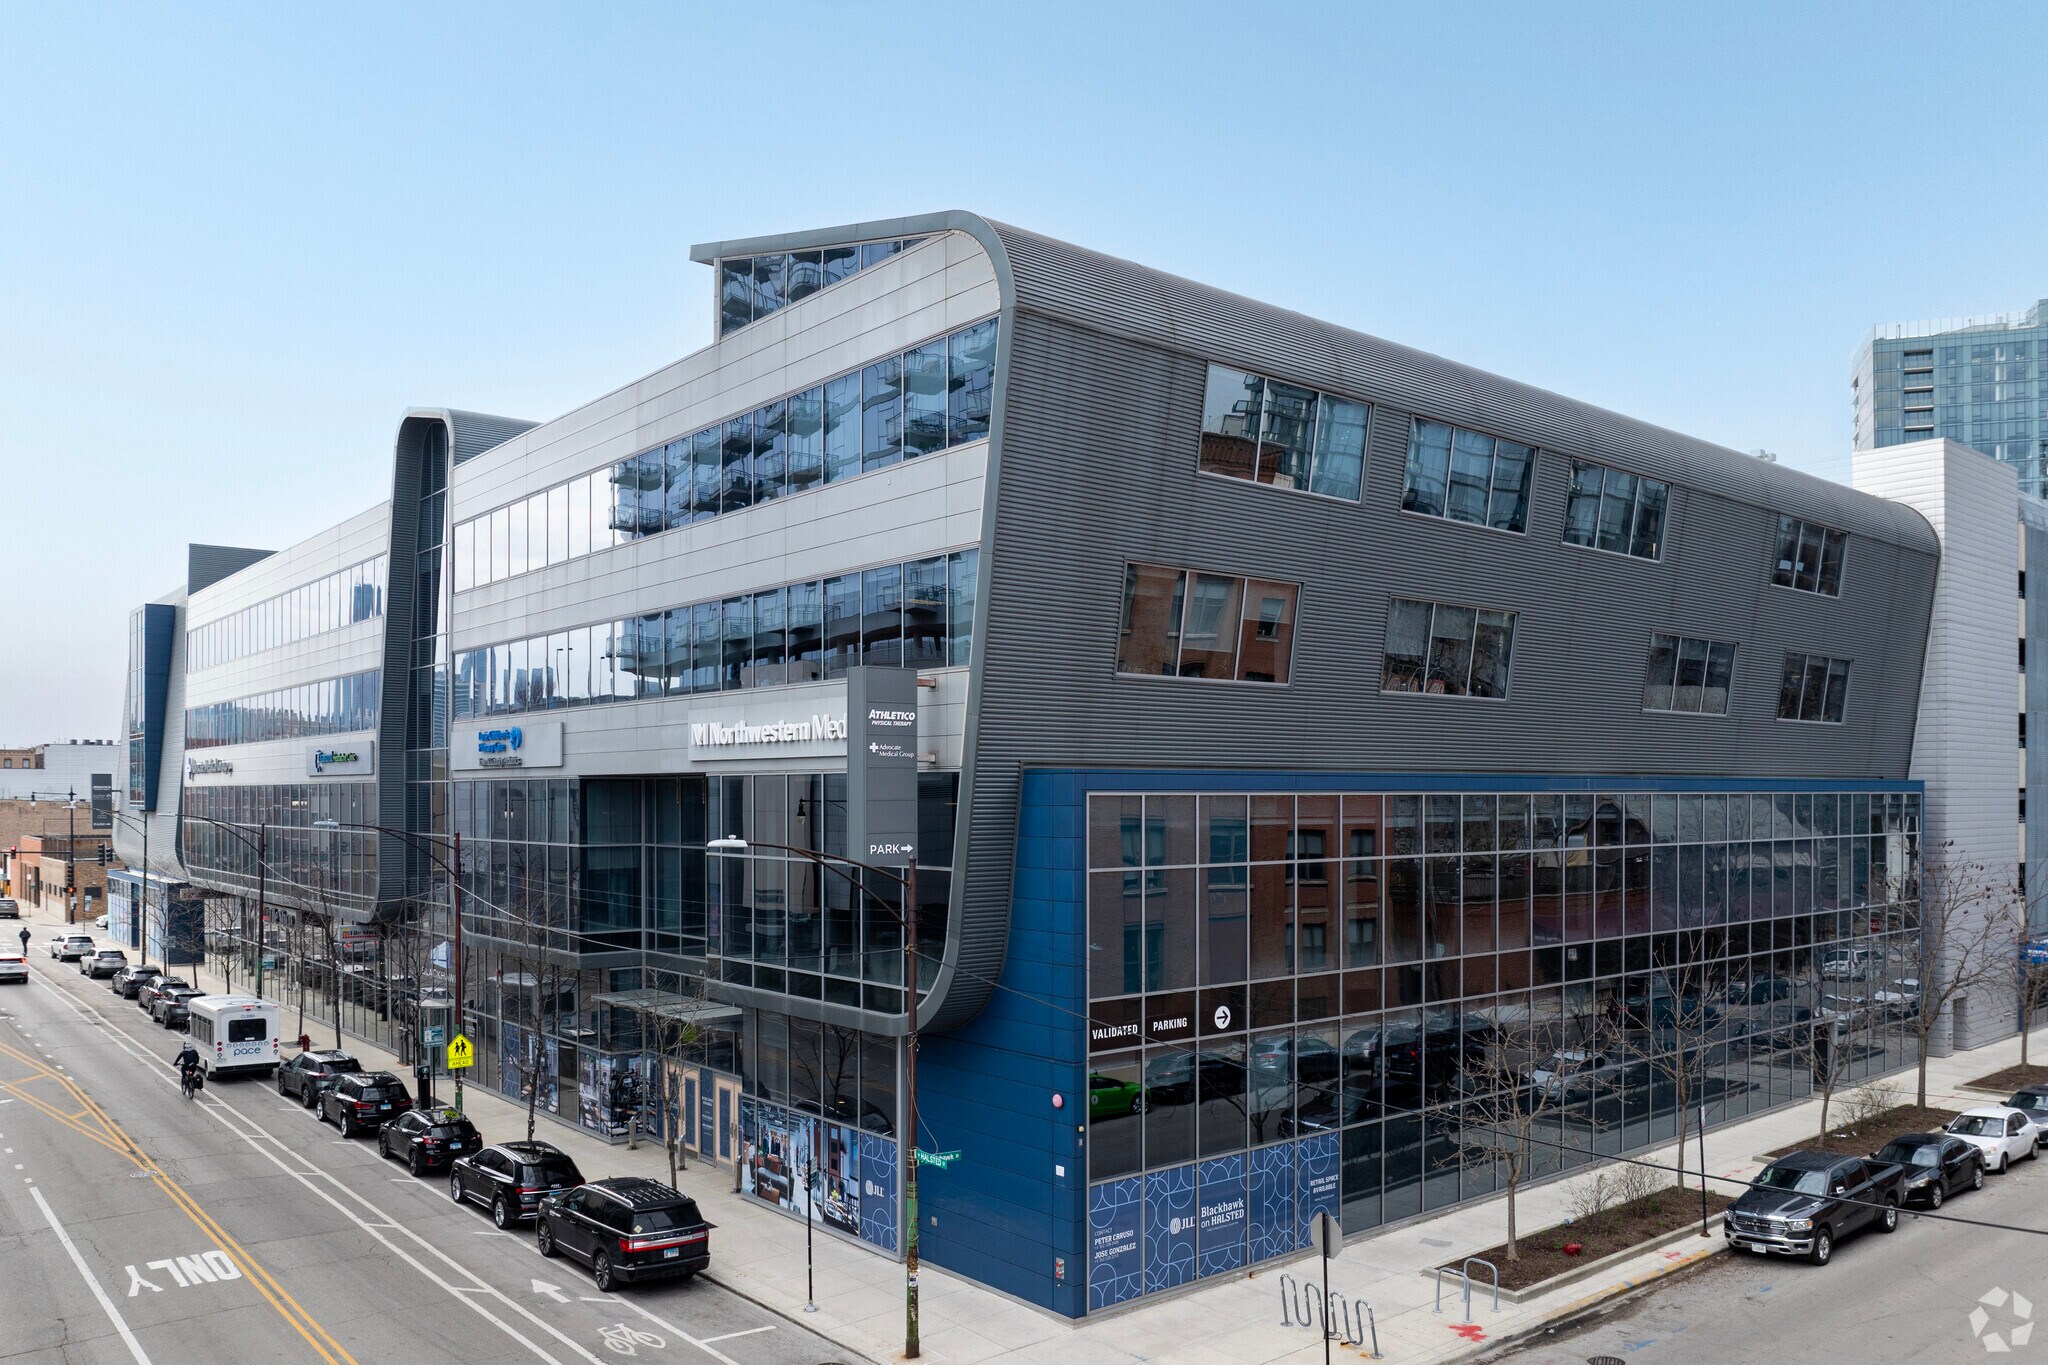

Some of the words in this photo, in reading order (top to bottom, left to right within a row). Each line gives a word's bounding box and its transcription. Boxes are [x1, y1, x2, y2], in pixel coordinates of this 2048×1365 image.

[868, 709, 916, 721] ATHLETICO
[709, 720, 811, 745] Northwestern
[898, 751, 915, 759] Group
[870, 844, 900, 855] PARK
[1092, 1024, 1138, 1040] VALIDATED
[1153, 1017, 1187, 1032] PARKING
[234, 1047, 261, 1057] pace
[451, 1059, 470, 1067] AHEAD
[920, 1152, 942, 1167] HALSTED
[1310, 1177, 1325, 1186] RETAIL
[1325, 1174, 1339, 1183] SPACE
[874, 1185, 884, 1198] JLL
[1313, 1182, 1336, 1194] AVAILABLE
[1201, 1198, 1244, 1218] Blackhawk
[1180, 1215, 1196, 1230] JLL
[1201, 1219, 1210, 1228] on
[1211, 1208, 1245, 1226] HALSTED
[1094, 1227, 1113, 1237] CONTACT
[1094, 1235, 1113, 1246] PETER
[1112, 1229, 1134, 1241] CARUSO
[1094, 1249, 1109, 1259] JOSE
[1108, 1242, 1137, 1256] GONZALEZ
[125, 1250, 242, 1297] ONLY
